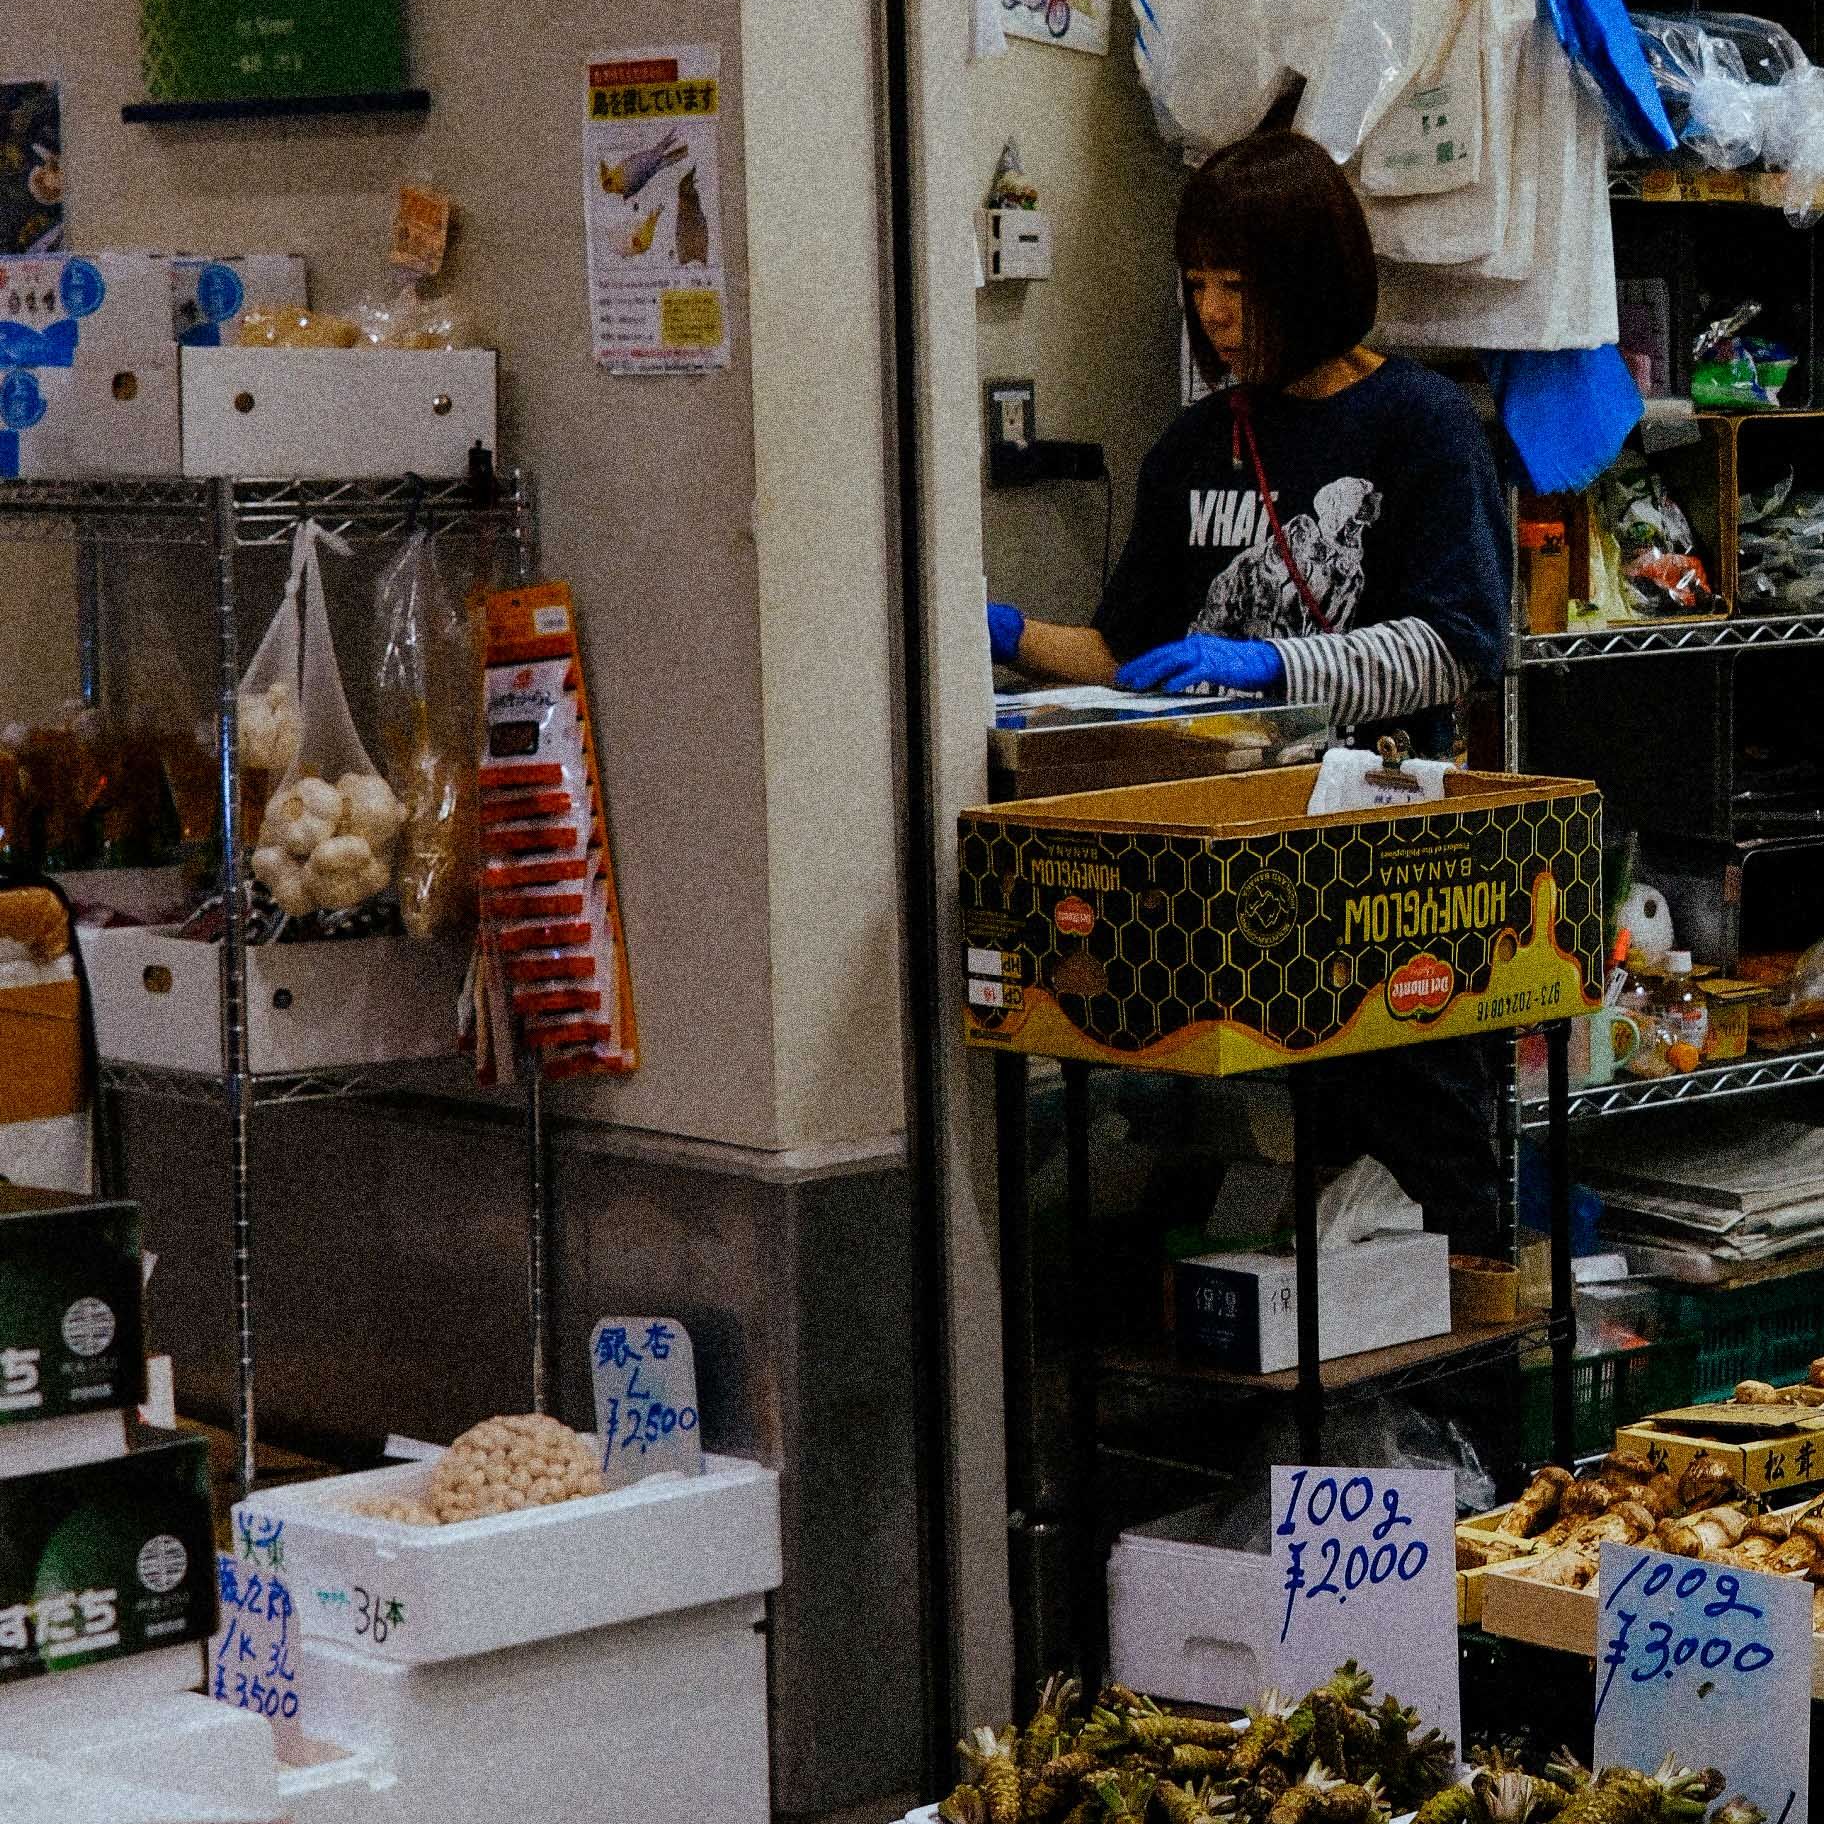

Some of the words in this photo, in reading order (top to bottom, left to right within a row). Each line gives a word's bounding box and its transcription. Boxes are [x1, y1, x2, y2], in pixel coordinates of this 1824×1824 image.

[1030, 858, 1122, 893] HONEYGLOW
[1379, 856, 1473, 887] BANANA
[1344, 880, 1507, 947] HONEYGLOW
[596, 1322, 675, 1367] 銀杏
[1763, 1440, 1815, 1481] 松茸
[1277, 1470, 1412, 1540] 100g
[1605, 1555, 1762, 1618] 100g
